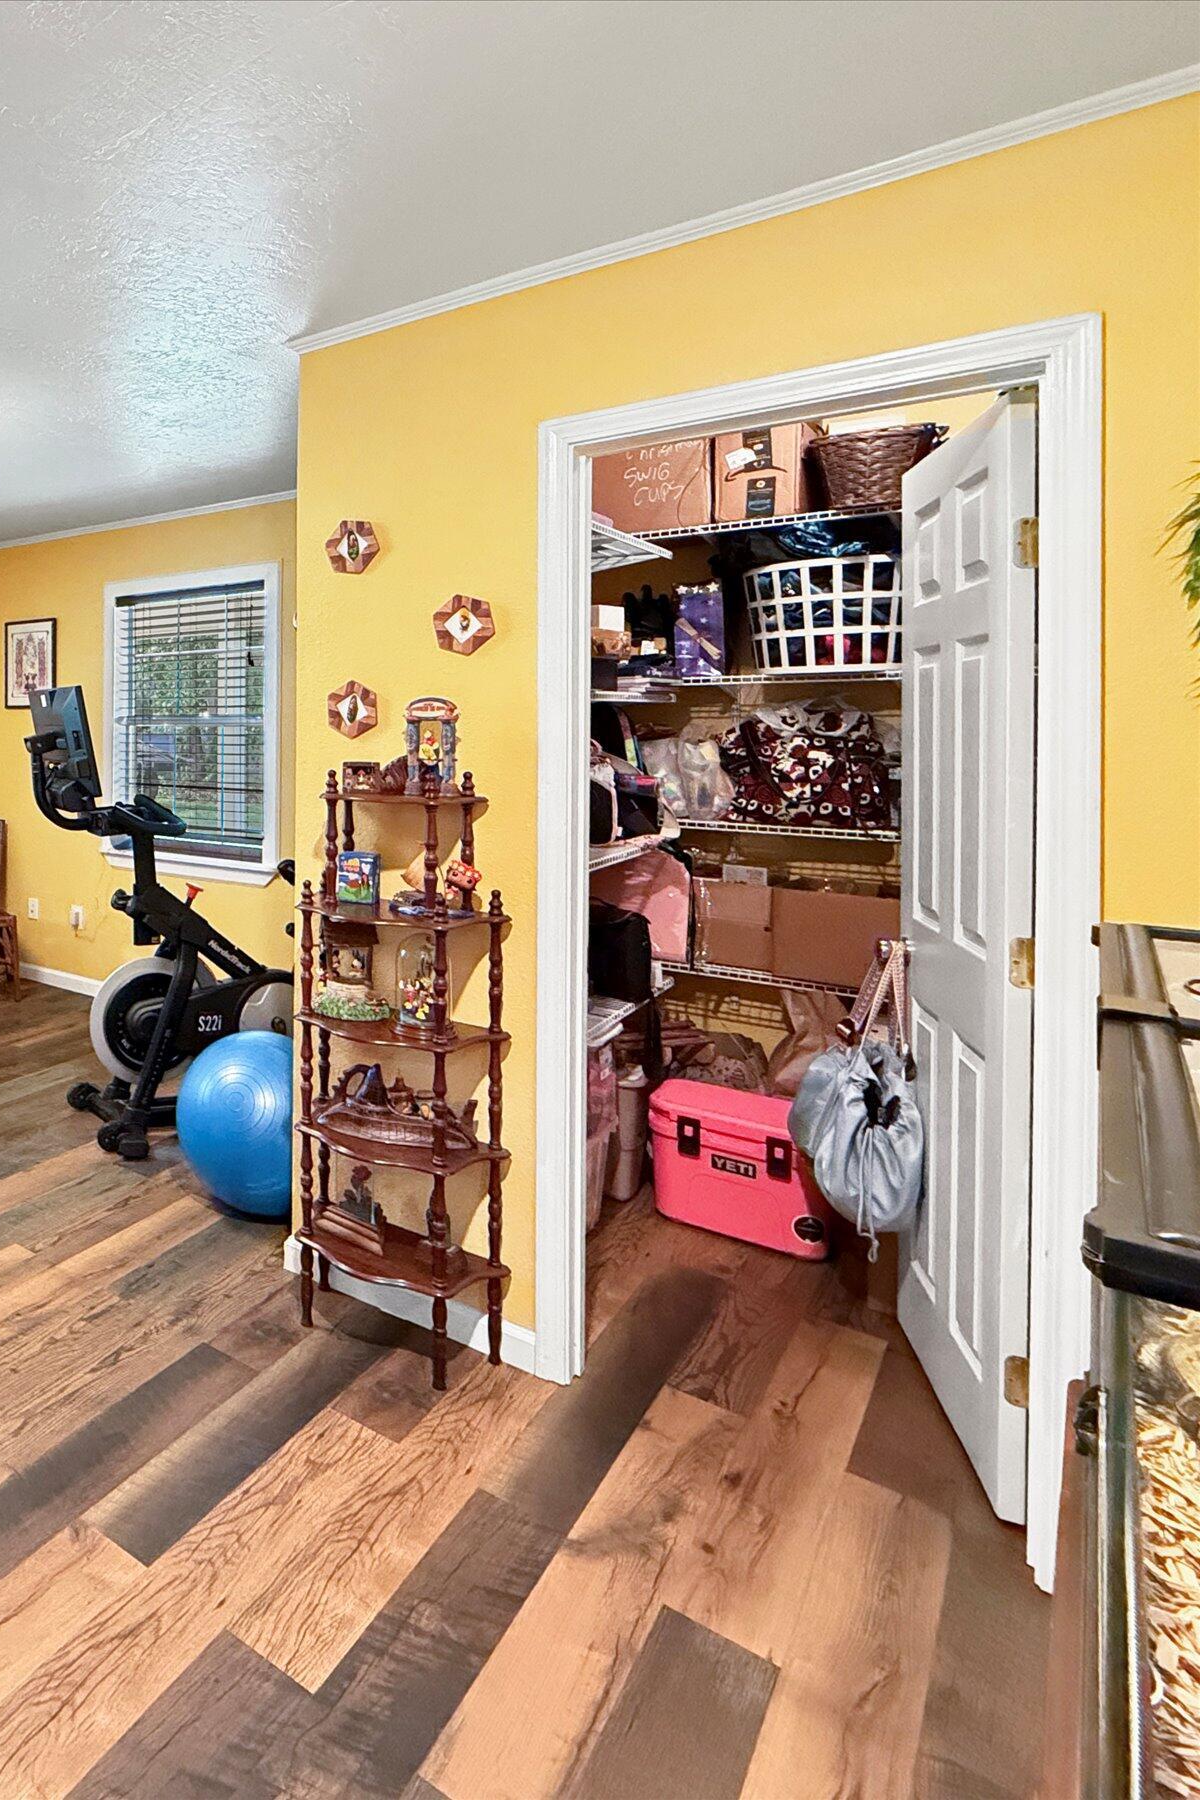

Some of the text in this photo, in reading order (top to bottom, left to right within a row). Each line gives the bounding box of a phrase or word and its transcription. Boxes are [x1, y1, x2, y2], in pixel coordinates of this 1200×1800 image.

[633, 480, 685, 507] CUPS
[197, 1015, 222, 1032] S22i
[713, 1156, 754, 1177] YETI
